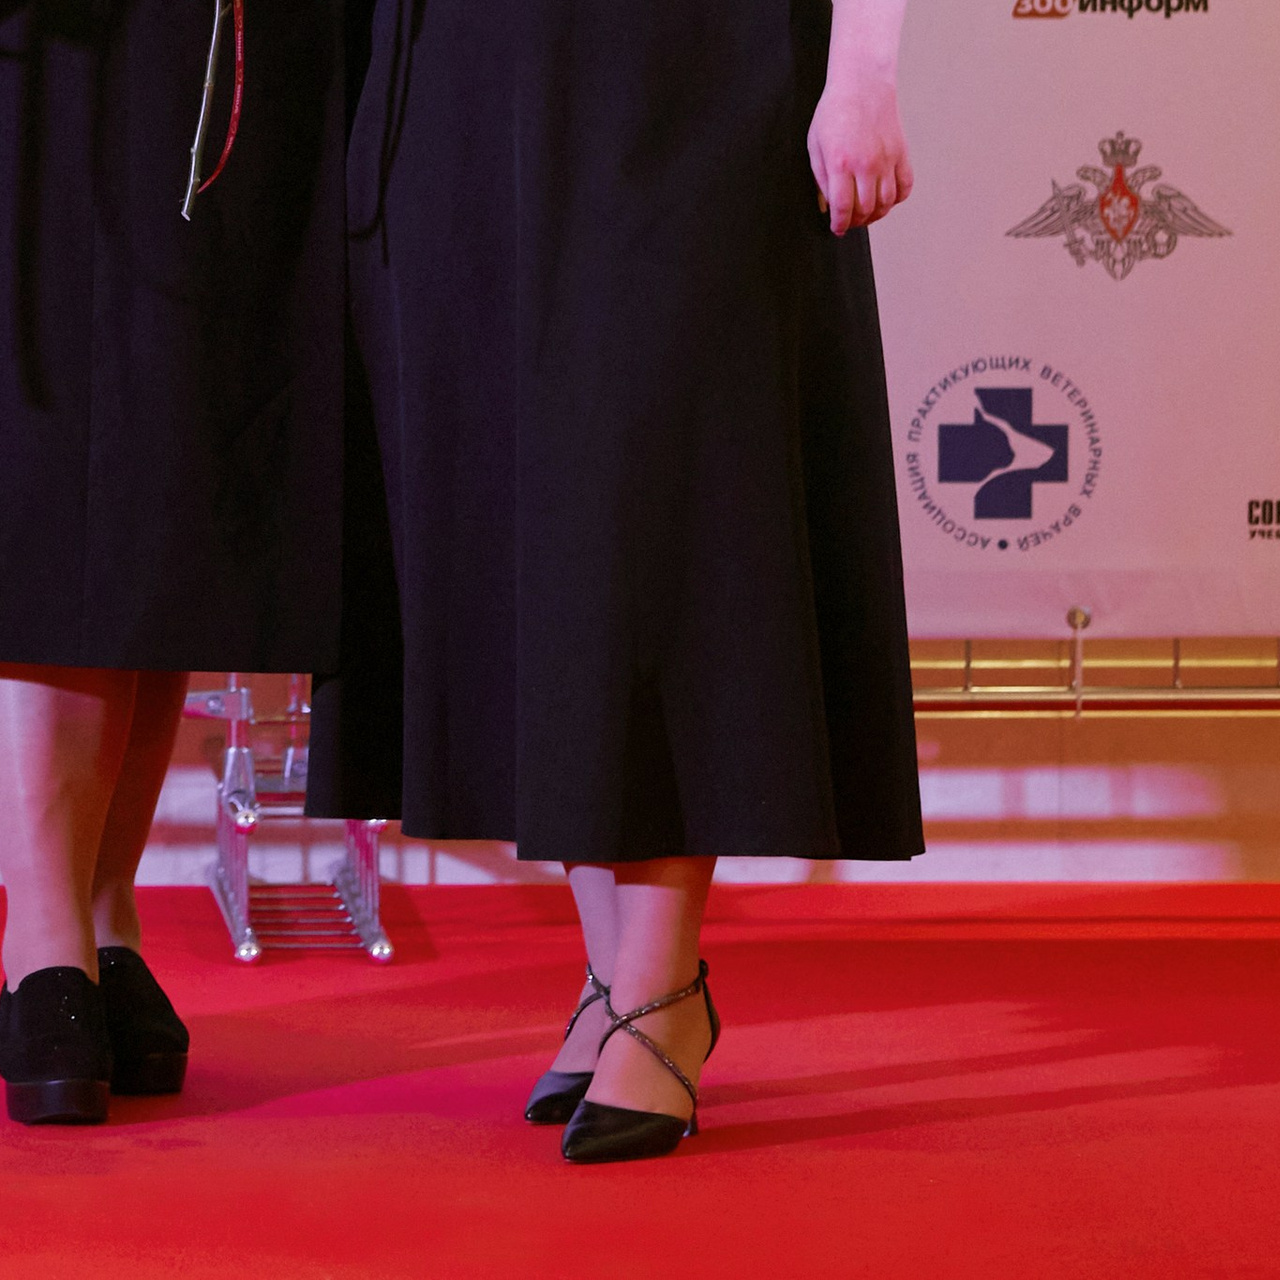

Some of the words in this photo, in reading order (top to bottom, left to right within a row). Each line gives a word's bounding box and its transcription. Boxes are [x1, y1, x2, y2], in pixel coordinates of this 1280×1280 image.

[908, 356, 1032, 442] ПРАКТИКУЮЩИХ
[1040, 365, 1103, 499] ВЕТЕРИНАРНЫХ
[906, 453, 991, 550] АССОЦИАЦИЯ
[1017, 504, 1082, 551] ВРАЧЕЙ
